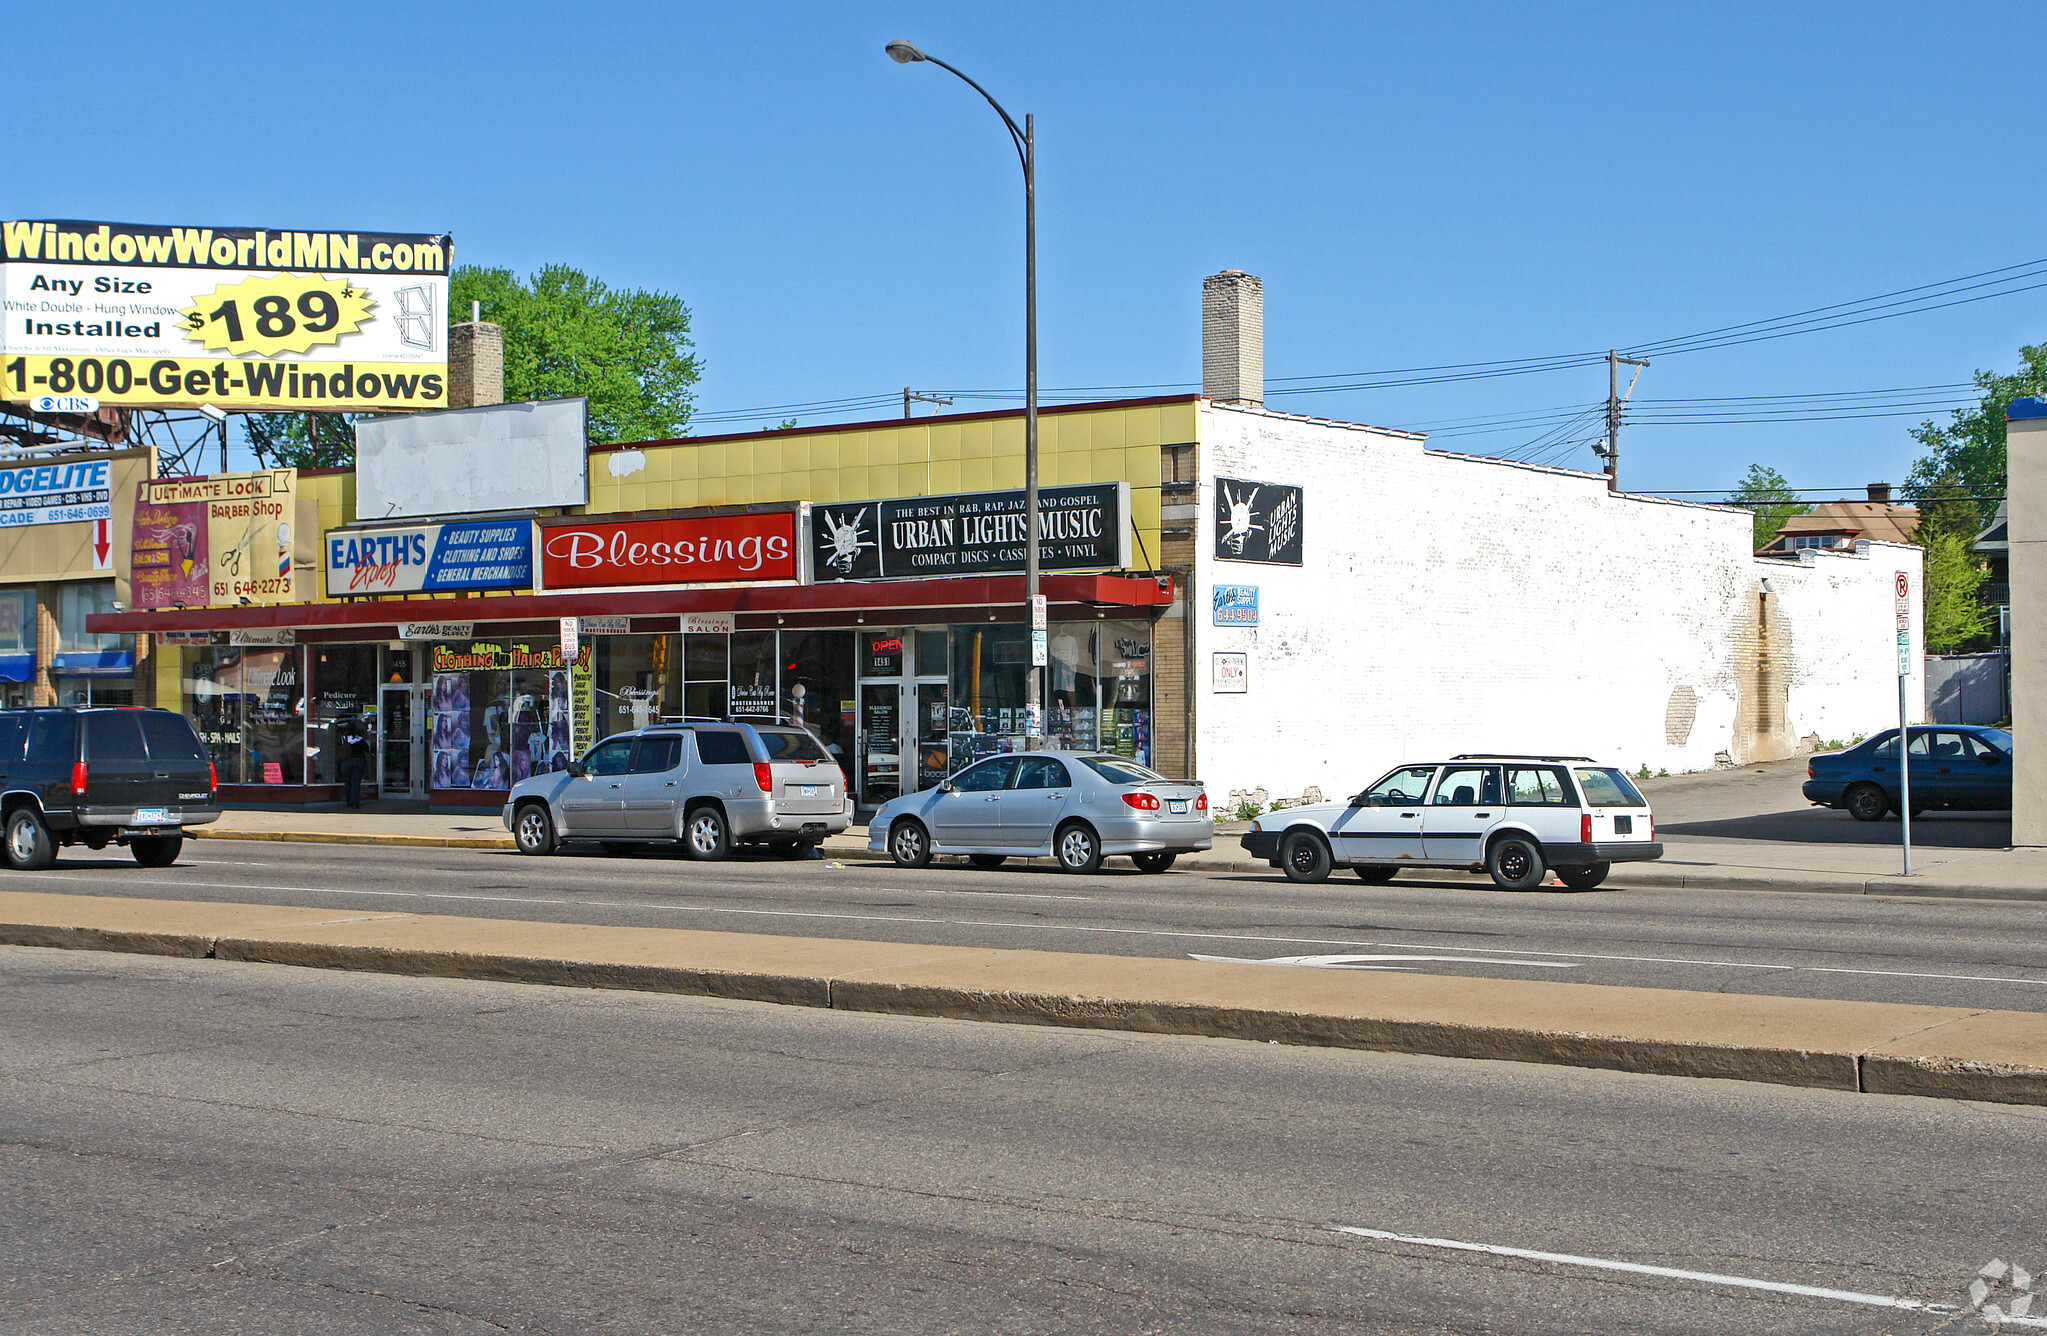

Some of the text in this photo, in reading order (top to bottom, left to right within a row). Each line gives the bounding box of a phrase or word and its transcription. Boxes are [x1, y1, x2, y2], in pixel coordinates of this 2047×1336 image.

[4, 221, 443, 271] WindowWorldMN.com
[30, 274, 152, 296] Any Size
[4, 301, 37, 312] White
[41, 302, 82, 313] Double
[95, 303, 126, 316] Hung
[130, 303, 177, 315] Window
[26, 318, 160, 337] Installed
[7, 356, 443, 400] 1-800-Get-Windows
[57, 397, 89, 411] CBS
[25, 497, 42, 508] VIDEO
[43, 494, 62, 506] GAMES
[80, 491, 93, 502] VHS
[96, 490, 108, 501] DVD
[896, 495, 1099, 518] THE BEST IN R&B, RAP, JAZ AND GOSPEL
[1270, 488, 1297, 527] URBAN
[0, 505, 110, 525] CADE 651-646-0699
[211, 500, 282, 520] BARBER Shop
[891, 508, 1102, 549] URBAN LIGHTS MUSIC
[1268, 503, 1297, 545] LIGHTS
[449, 528, 517, 544] BEAUTY SUPPLIES
[1268, 520, 1296, 560] MUSIC
[331, 533, 426, 569] EARTH'S
[443, 546, 525, 563] CLOTHING AND SHOES
[546, 530, 789, 571] Blessings
[911, 552, 957, 567] COMPACT
[961, 550, 989, 564] DISCS
[1065, 544, 1097, 557] VINYL
[350, 553, 402, 590] Express
[436, 564, 528, 582] GENERAL MERCHANDISE
[214, 582, 229, 596] 651
[1237, 596, 1255, 605] SUPPLY
[687, 616, 729, 625] Blessings
[687, 625, 730, 633] SALON
[230, 630, 274, 645] Ultimate
[405, 622, 441, 638] Earth's
[872, 639, 903, 652] OPEN
[434, 645, 494, 670] CLOTHING
[511, 646, 544, 668] HAIR
[276, 666, 297, 687] Look
[1221, 666, 1238, 678] ONLY
[323, 691, 357, 699] Pedicure
[619, 685, 660, 698] Blessings
[325, 701, 333, 709] &
[335, 701, 355, 709] Nails
[210, 732, 221, 743] SPA
[225, 732, 241, 744] NAILS
[924, 770, 947, 780] boos
